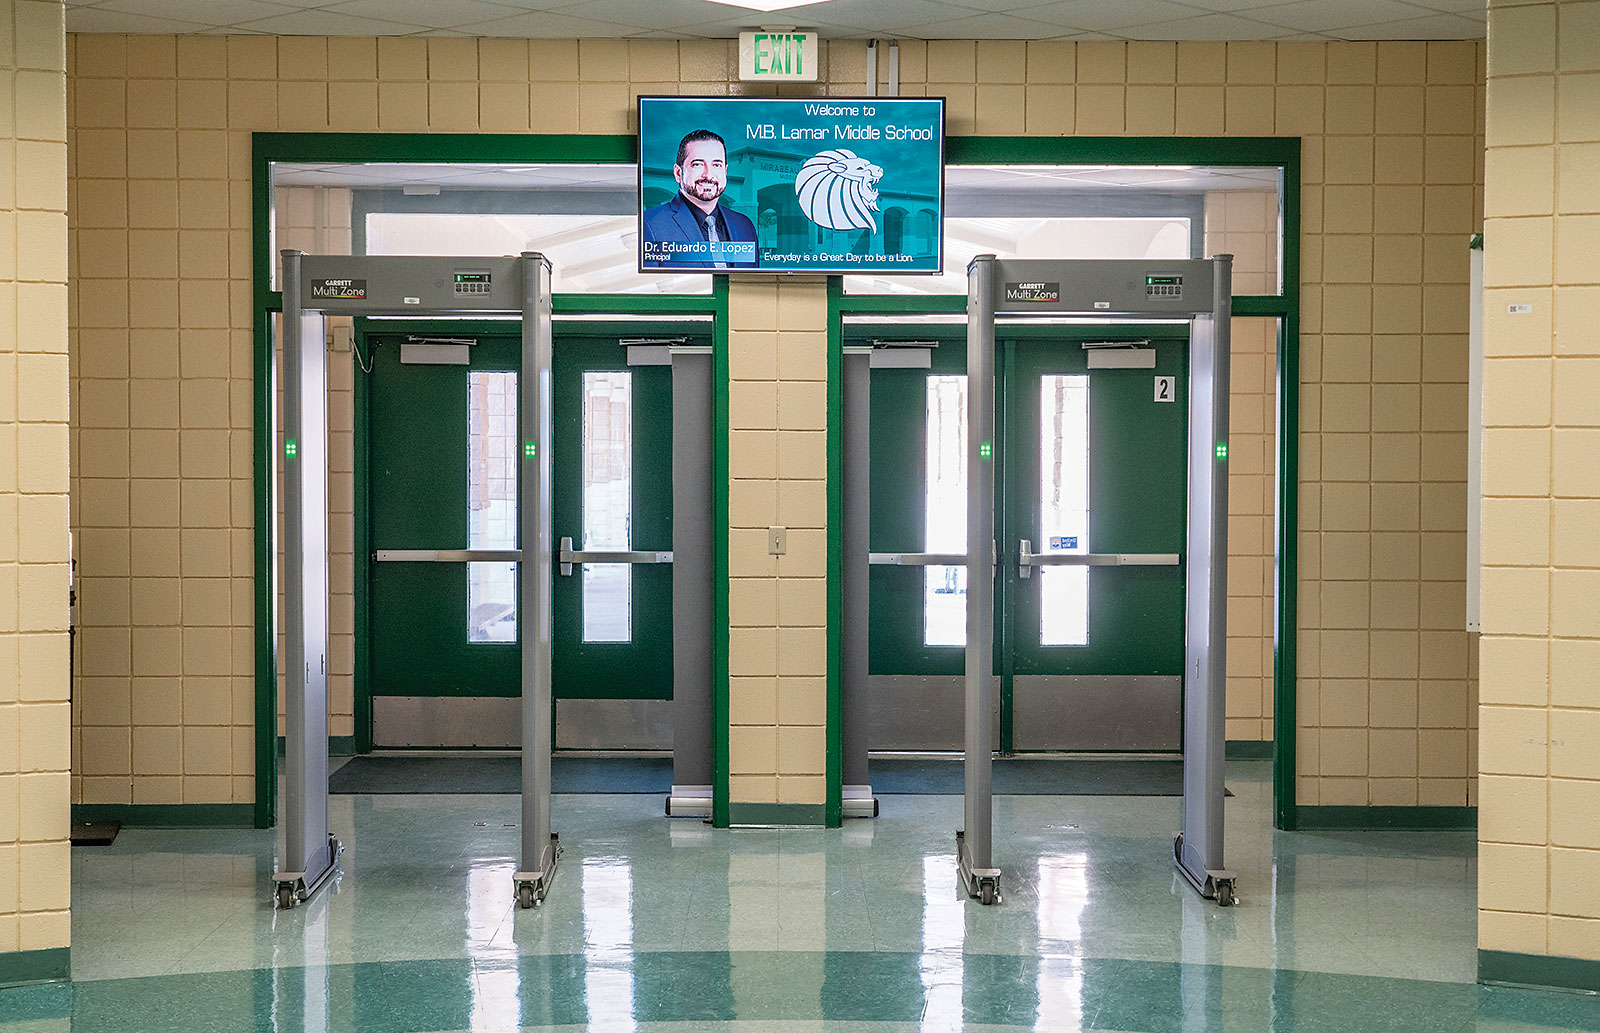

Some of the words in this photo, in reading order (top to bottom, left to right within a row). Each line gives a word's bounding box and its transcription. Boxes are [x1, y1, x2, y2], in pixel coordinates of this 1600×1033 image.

[754, 34, 807, 75] EXIT
[804, 103, 859, 116] Welcome
[862, 104, 876, 116] to
[746, 124, 777, 140] M.B.
[781, 124, 830, 140] Lamar
[834, 124, 881, 140] Middle
[885, 125, 933, 141] School
[644, 241, 660, 253] Dr.
[662, 241, 708, 253] Eduardo
[709, 242, 719, 253] E.
[721, 242, 754, 255] Lopez
[644, 253, 671, 262] Principal
[764, 252, 801, 263] Everyday
[803, 253, 810, 262] is
[812, 254, 818, 262] a
[819, 252, 844, 262] Great
[846, 252, 862, 263] Day
[864, 253, 874, 262] to
[876, 252, 886, 262] be
[888, 254, 894, 262] a
[313, 286, 338, 296] Multi
[340, 286, 365, 296] Zone
[1007, 289, 1031, 299] Multi
[1033, 289, 1058, 299] Zone
[1159, 379, 1168, 399] 2
